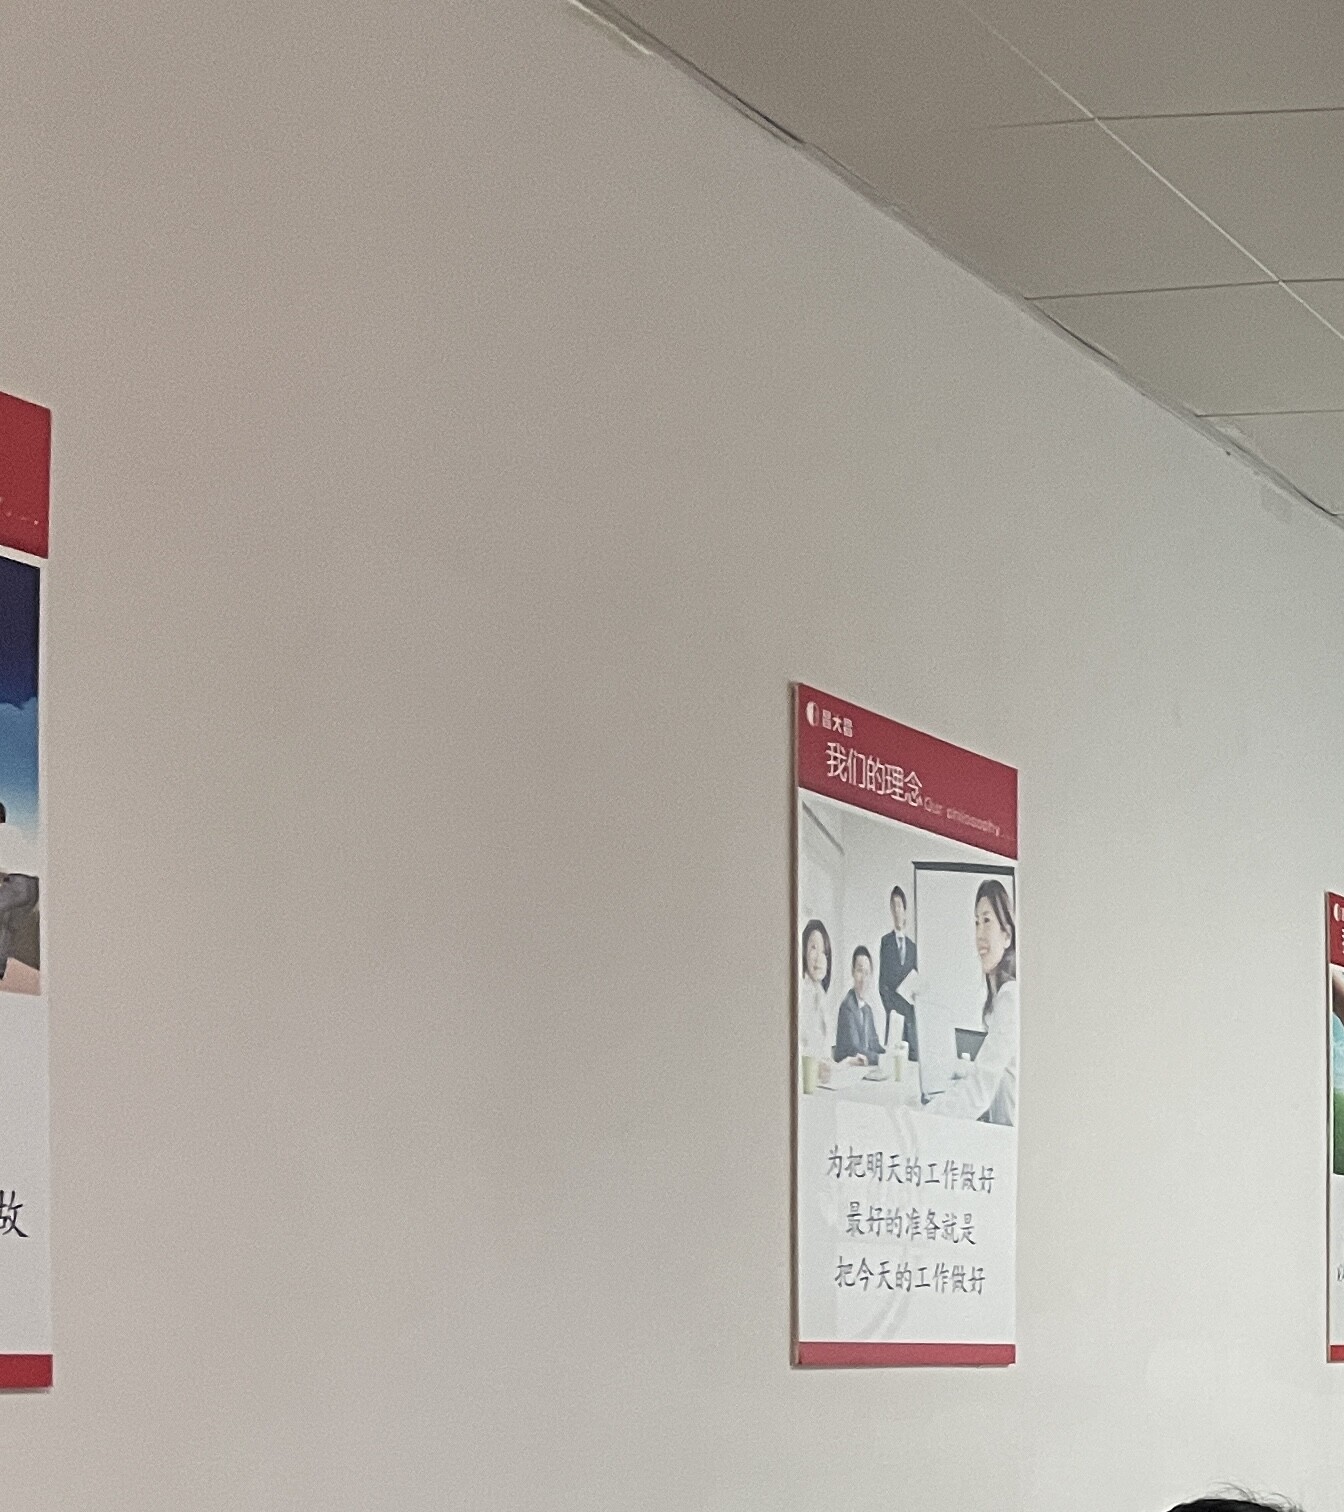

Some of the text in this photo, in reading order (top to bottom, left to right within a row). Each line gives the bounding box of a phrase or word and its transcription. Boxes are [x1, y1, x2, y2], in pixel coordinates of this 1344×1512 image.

[825, 742, 923, 807] 我们的理念
[827, 1144, 995, 1194] 为把明天的工作做好
[846, 1200, 977, 1245] 最好的准备就是
[835, 1256, 986, 1296] 把今天的工作做好
